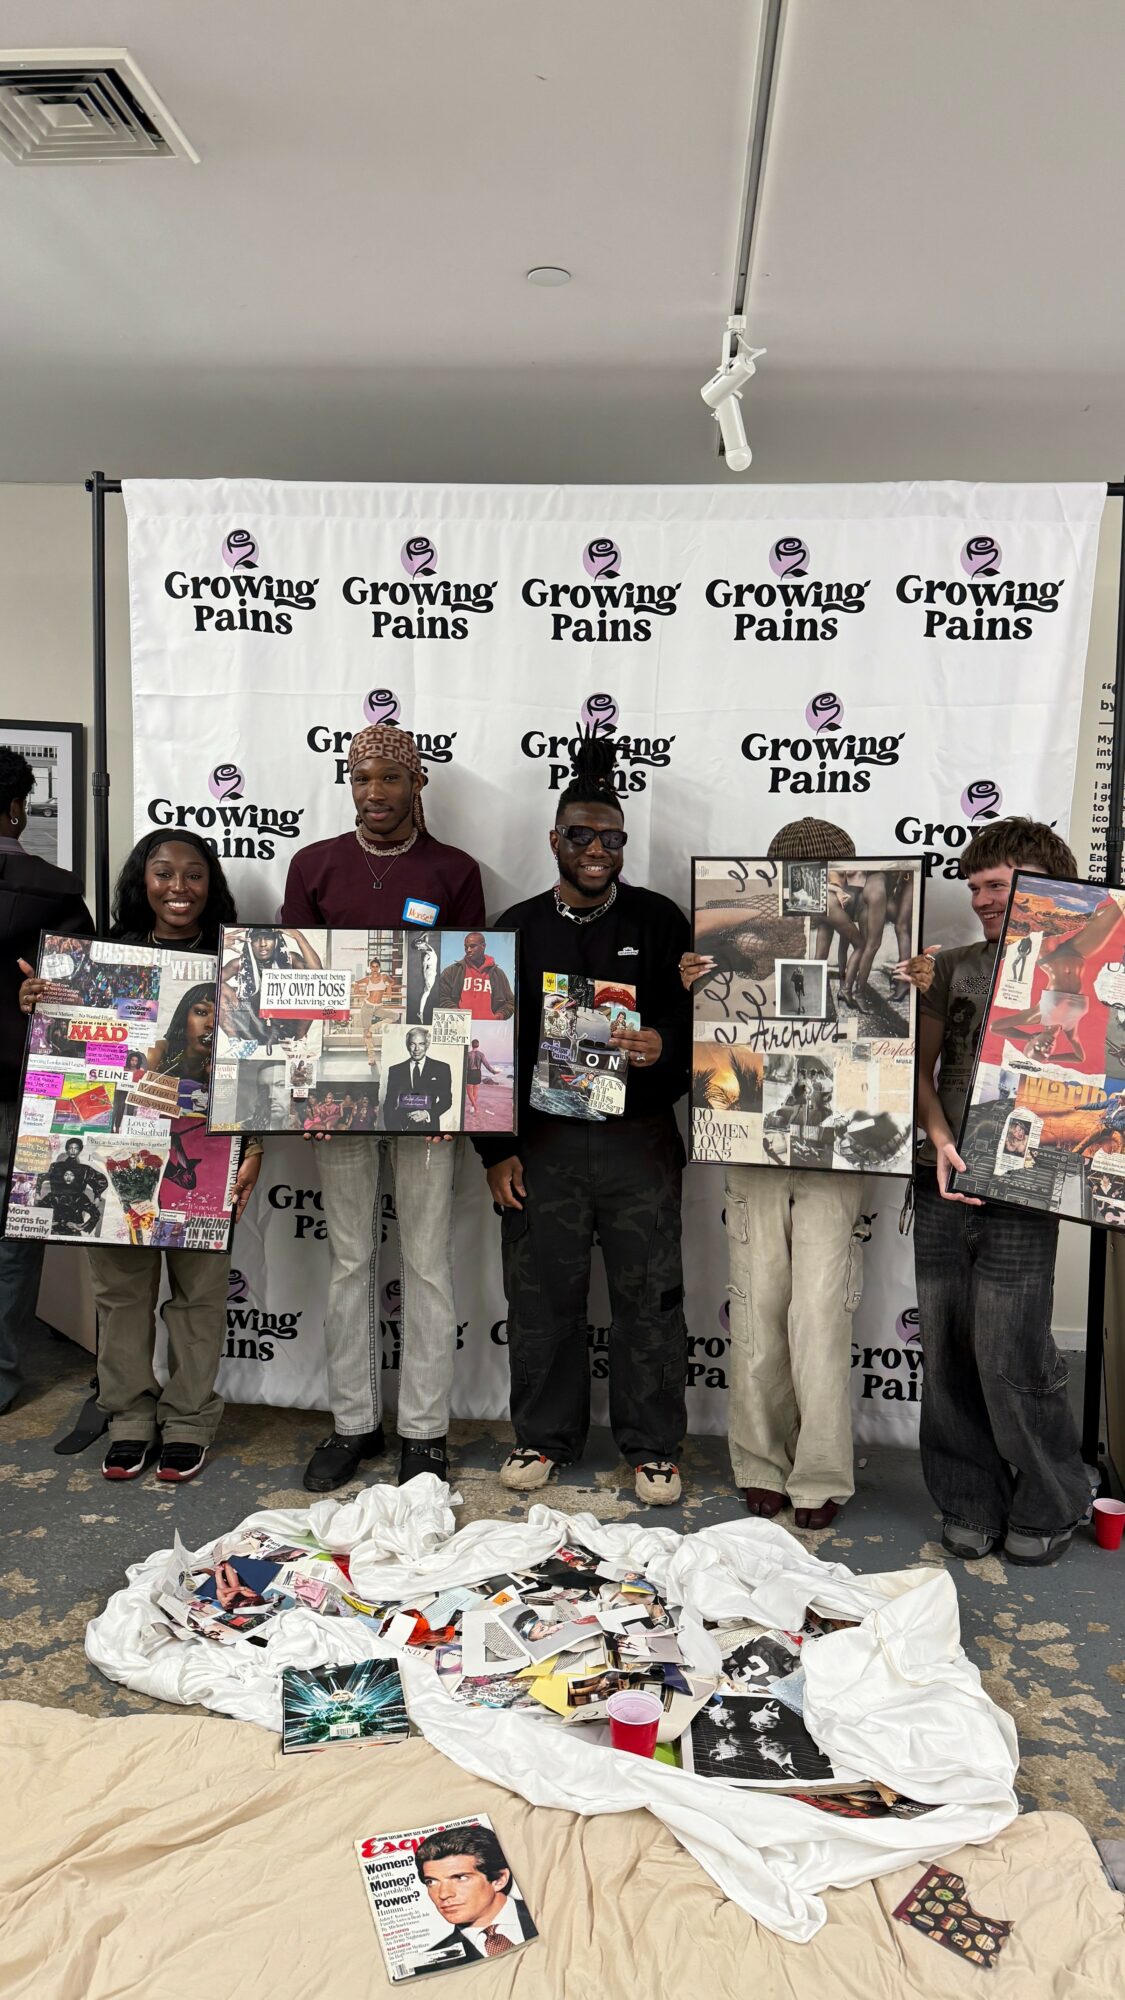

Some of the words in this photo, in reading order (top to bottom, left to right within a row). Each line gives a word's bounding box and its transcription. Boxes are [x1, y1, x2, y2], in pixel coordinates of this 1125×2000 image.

[164, 571, 319, 610] Growing
[342, 577, 498, 613] Growing
[522, 578, 681, 615] Growing
[706, 579, 871, 614] Growing
[896, 574, 1064, 613] Growing
[194, 600, 293, 634] Pains
[372, 604, 469, 639] Pains
[551, 608, 651, 642] Pains
[734, 609, 838, 641] Pains
[924, 609, 1033, 640] Pains
[741, 731, 906, 767] Growing
[768, 761, 871, 793] Pains
[147, 799, 305, 838] Growing
[204, 829, 275, 860] ains
[171, 960, 213, 980] WITH
[295, 973, 309, 981] thing
[330, 973, 346, 981] being
[267, 982, 285, 998] my
[289, 982, 314, 997] own
[319, 980, 345, 997] boss
[464, 977, 492, 994] USA
[277, 998, 291, 1006] not
[295, 998, 325, 1007] having
[68, 1025, 128, 1042] MAD
[148, 1120, 156, 1128] &
[692, 1108, 713, 1121] DO
[693, 1121, 749, 1138] WOMEN
[693, 1136, 731, 1150] LOVE
[9, 1207, 30, 1215] More
[35, 1217, 48, 1225] for
[21, 1224, 49, 1235] family
[188, 1229, 199, 1239] IN
[202, 1230, 225, 1240] NEW
[365, 1855, 414, 1875] Women?
[370, 1873, 415, 1892] Money?
[375, 1891, 420, 1910] Power?
